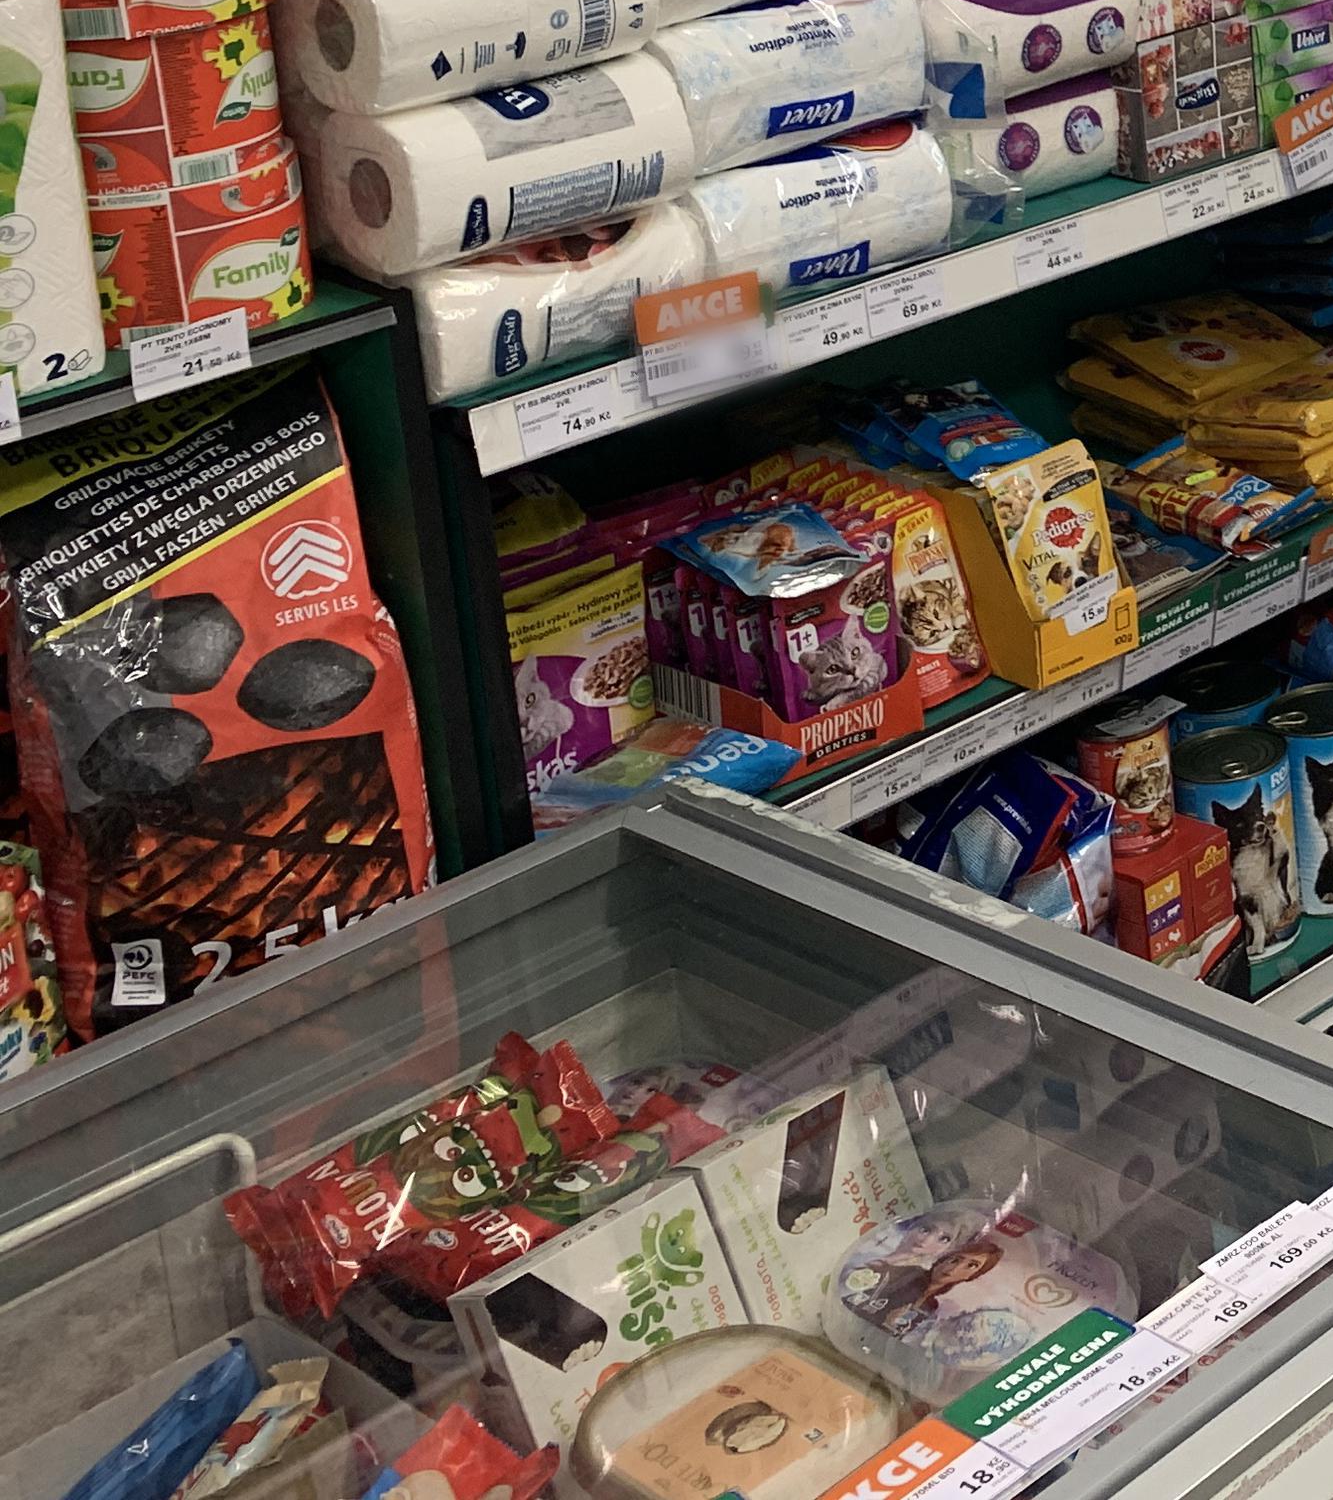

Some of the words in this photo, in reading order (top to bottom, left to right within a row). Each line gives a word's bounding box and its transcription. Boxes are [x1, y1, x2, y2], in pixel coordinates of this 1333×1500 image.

[749, 35, 794, 53] edition
[1297, 29, 1327, 49] Velvet
[212, 250, 290, 289] Family
[656, 285, 745, 333] AKCE
[42, 352, 68, 382] 2
[599, 412, 612, 425] Kč
[166, 419, 236, 467] BRIKETY
[89, 484, 145, 518] GRILL
[145, 442, 230, 490] BRIKETTS
[20, 510, 133, 583] BRIQUETTES
[133, 491, 162, 519] DE
[161, 448, 251, 501] CHARBON
[251, 433, 277, 455] DE
[276, 411, 321, 441] BOIS
[43, 540, 129, 600] BRYKIETY
[130, 529, 148, 549] Z
[147, 495, 215, 540] WĘGLA
[212, 431, 326, 501] DRZEWNEGO
[101, 558, 158, 592] GRILL
[235, 470, 299, 516] BRIKET
[1033, 509, 1095, 546] Pedigree
[1023, 551, 1056, 571] VITAL
[1272, 560, 1296, 580] CENA
[274, 599, 327, 628] SERVIS
[331, 594, 359, 615] LES
[1154, 599, 1191, 623] TRVALE
[1182, 602, 1210, 622] CENA
[800, 697, 884, 754] PROPESKO
[816, 731, 868, 760] DENTIES
[1258, 1212, 1294, 1238] BAILEYS
[1318, 1226, 1333, 1243] Kč
[995, 1342, 1066, 1393] TRVALE
[1163, 1353, 1181, 1369] Kč
[974, 1359, 1073, 1429] VÝHODNÁ
[1069, 1328, 1120, 1367] CENA
[841, 1441, 944, 1500] KCE
[960, 1469, 993, 1494] 18
